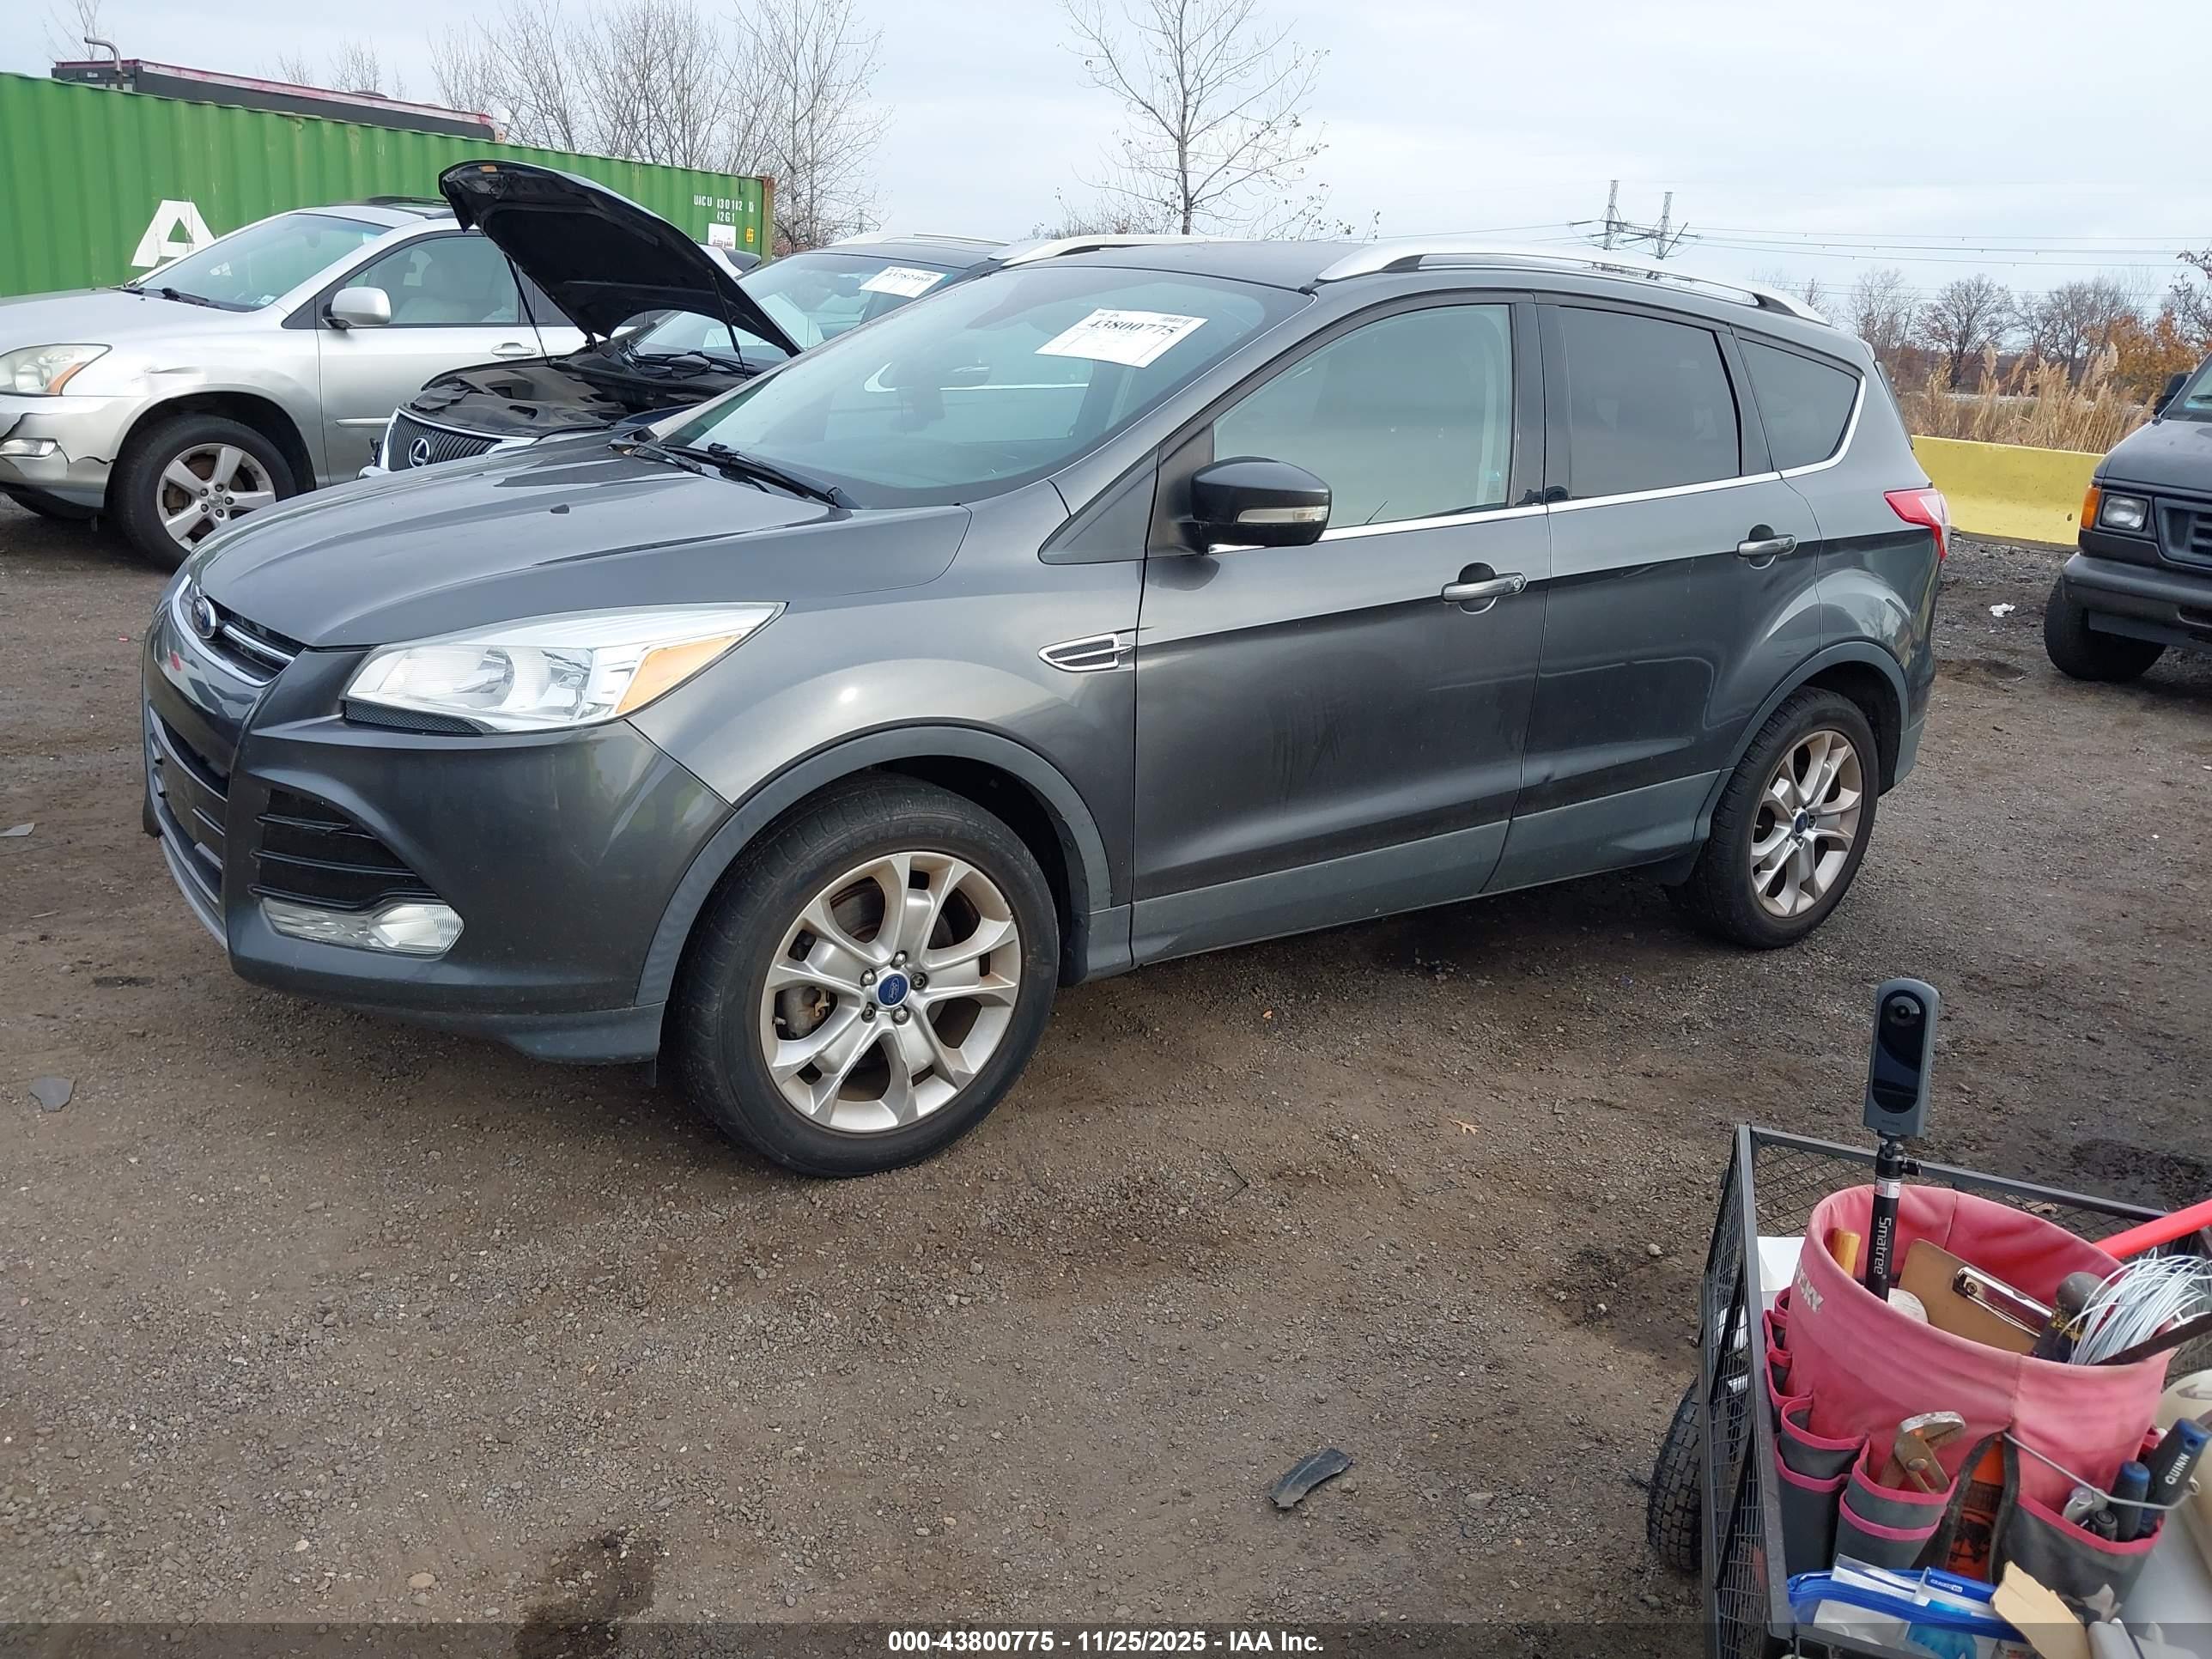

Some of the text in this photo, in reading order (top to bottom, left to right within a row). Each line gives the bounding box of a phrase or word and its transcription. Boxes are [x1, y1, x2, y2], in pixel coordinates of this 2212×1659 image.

[1087, 319, 1181, 336] 43800775
[1873, 1216, 1893, 1275] Smatree
[2165, 1452, 2191, 1485] QUINN
